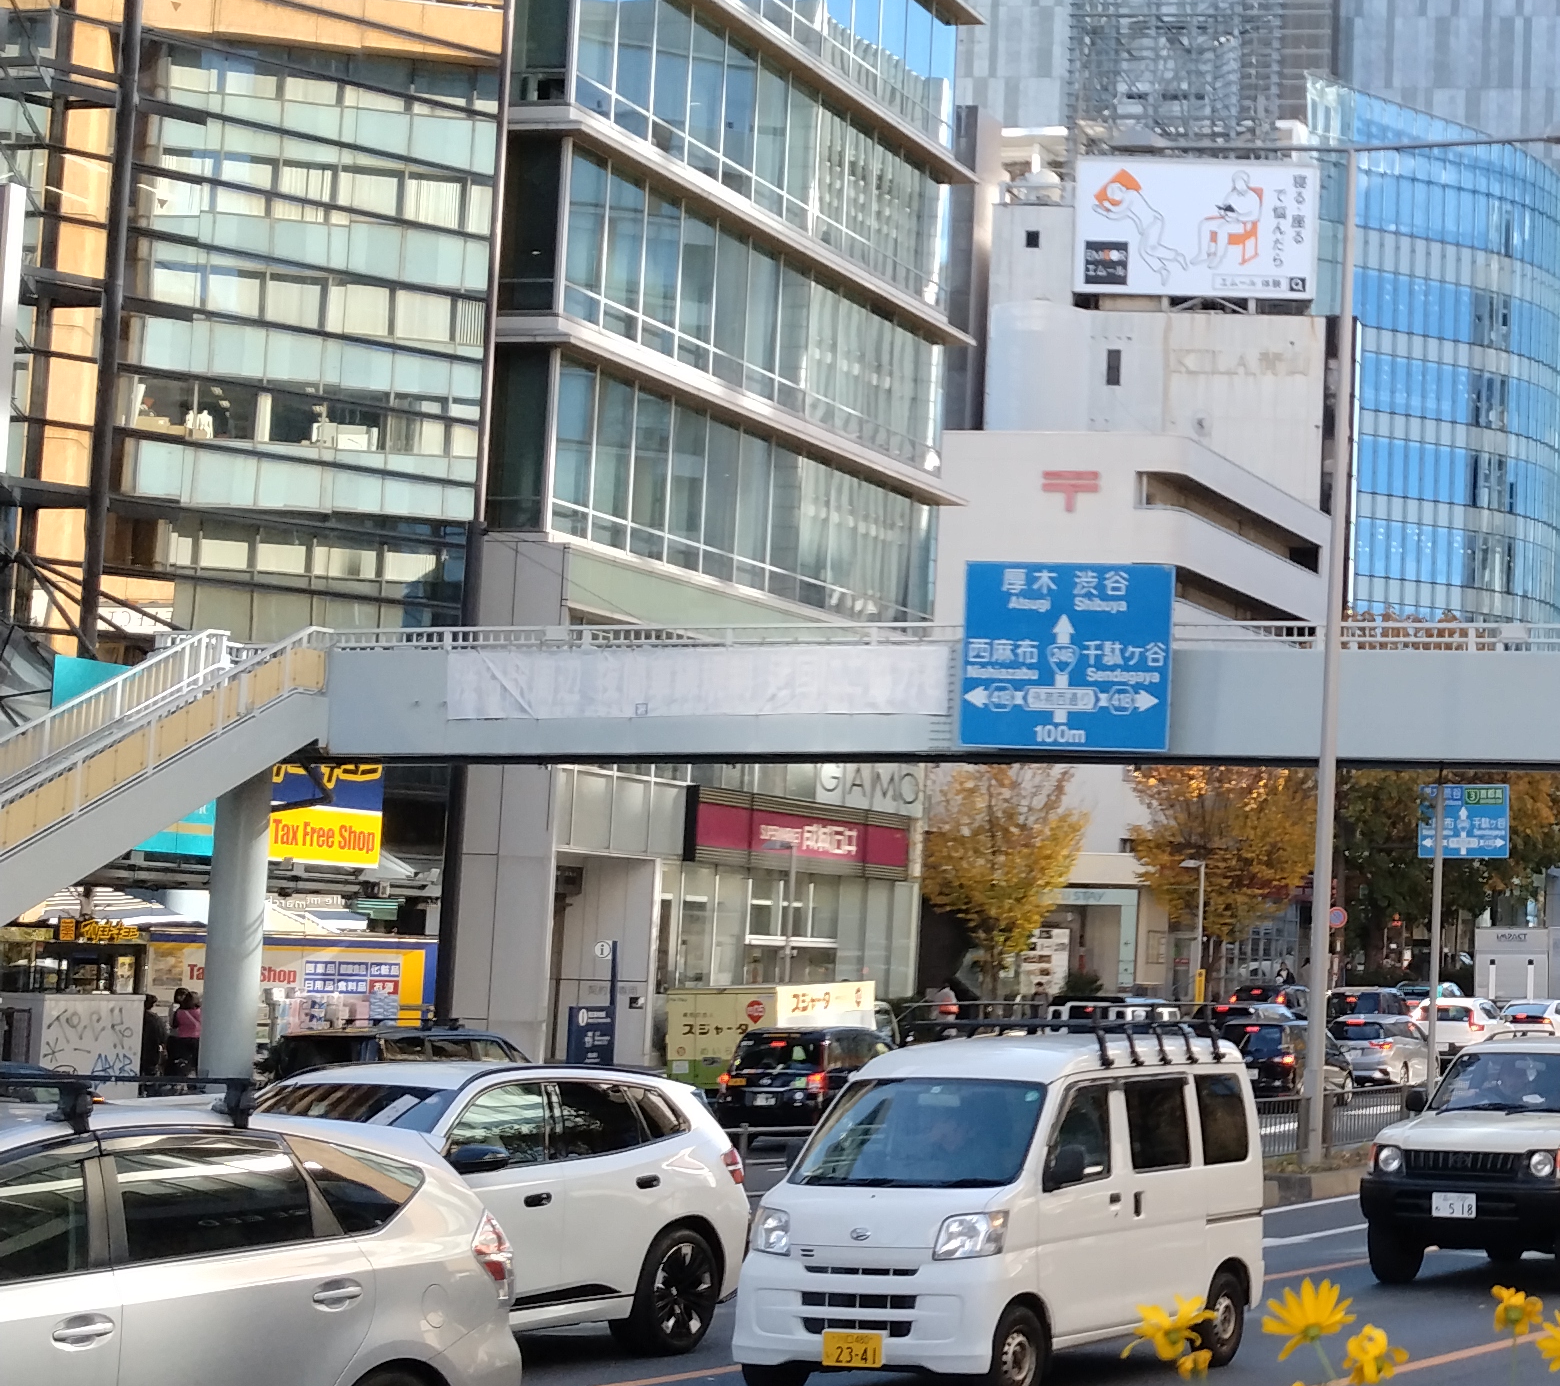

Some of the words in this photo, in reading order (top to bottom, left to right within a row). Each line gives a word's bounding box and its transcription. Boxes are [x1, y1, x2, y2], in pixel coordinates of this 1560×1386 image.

[1002, 568, 1058, 594] 厚木
[1073, 570, 1129, 595] 渋谷
[1007, 597, 1051, 612] Atsugi
[1073, 597, 1128, 613] Shibuya
[967, 639, 1039, 664] 西麻布
[1086, 668, 1160, 684] Sendagaya
[1034, 725, 1086, 743] 100m
[820, 763, 920, 805] GAMO
[272, 818, 300, 846] Tax
[302, 821, 335, 849] Free
[338, 824, 376, 854] Shop
[1496, 933, 1528, 941] IMPACT
[370, 964, 400, 976] 化粧品
[305, 980, 335, 991] 日用品
[682, 1023, 749, 1036] スジャータ
[834, 1346, 877, 1364] 23-41
